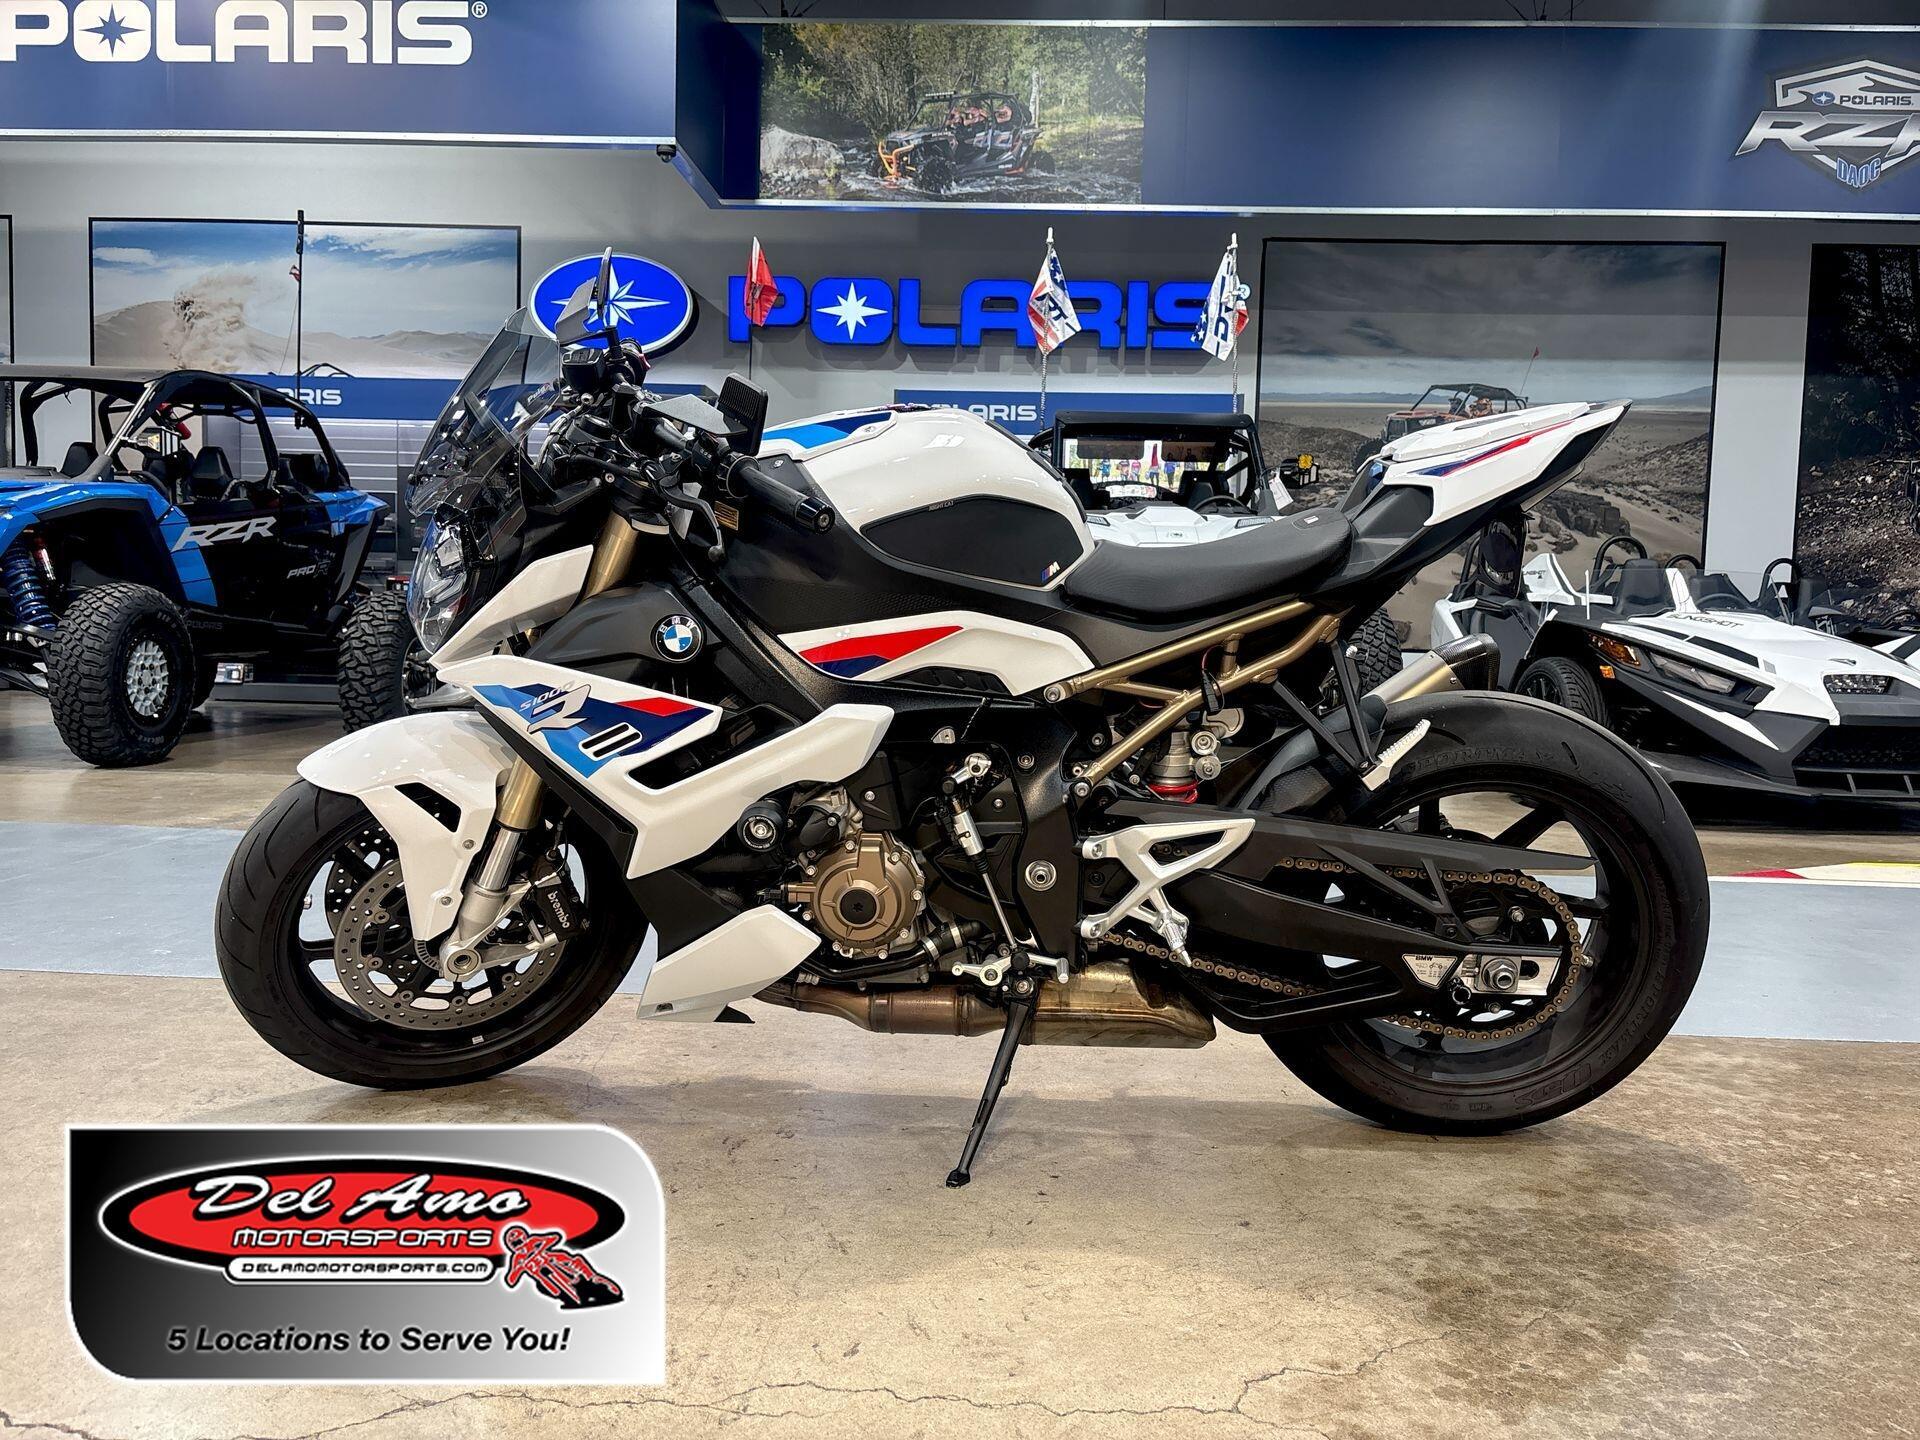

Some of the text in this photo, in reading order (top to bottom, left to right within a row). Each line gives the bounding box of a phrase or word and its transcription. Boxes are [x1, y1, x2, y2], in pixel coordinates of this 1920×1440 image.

[0, 0, 473, 65] POLARIS
[1839, 95, 1913, 106] POLARIS
[170, 516, 277, 553] RZR
[287, 566, 316, 580] PRO
[659, 616, 696, 633] BMW
[547, 890, 570, 929] brembo
